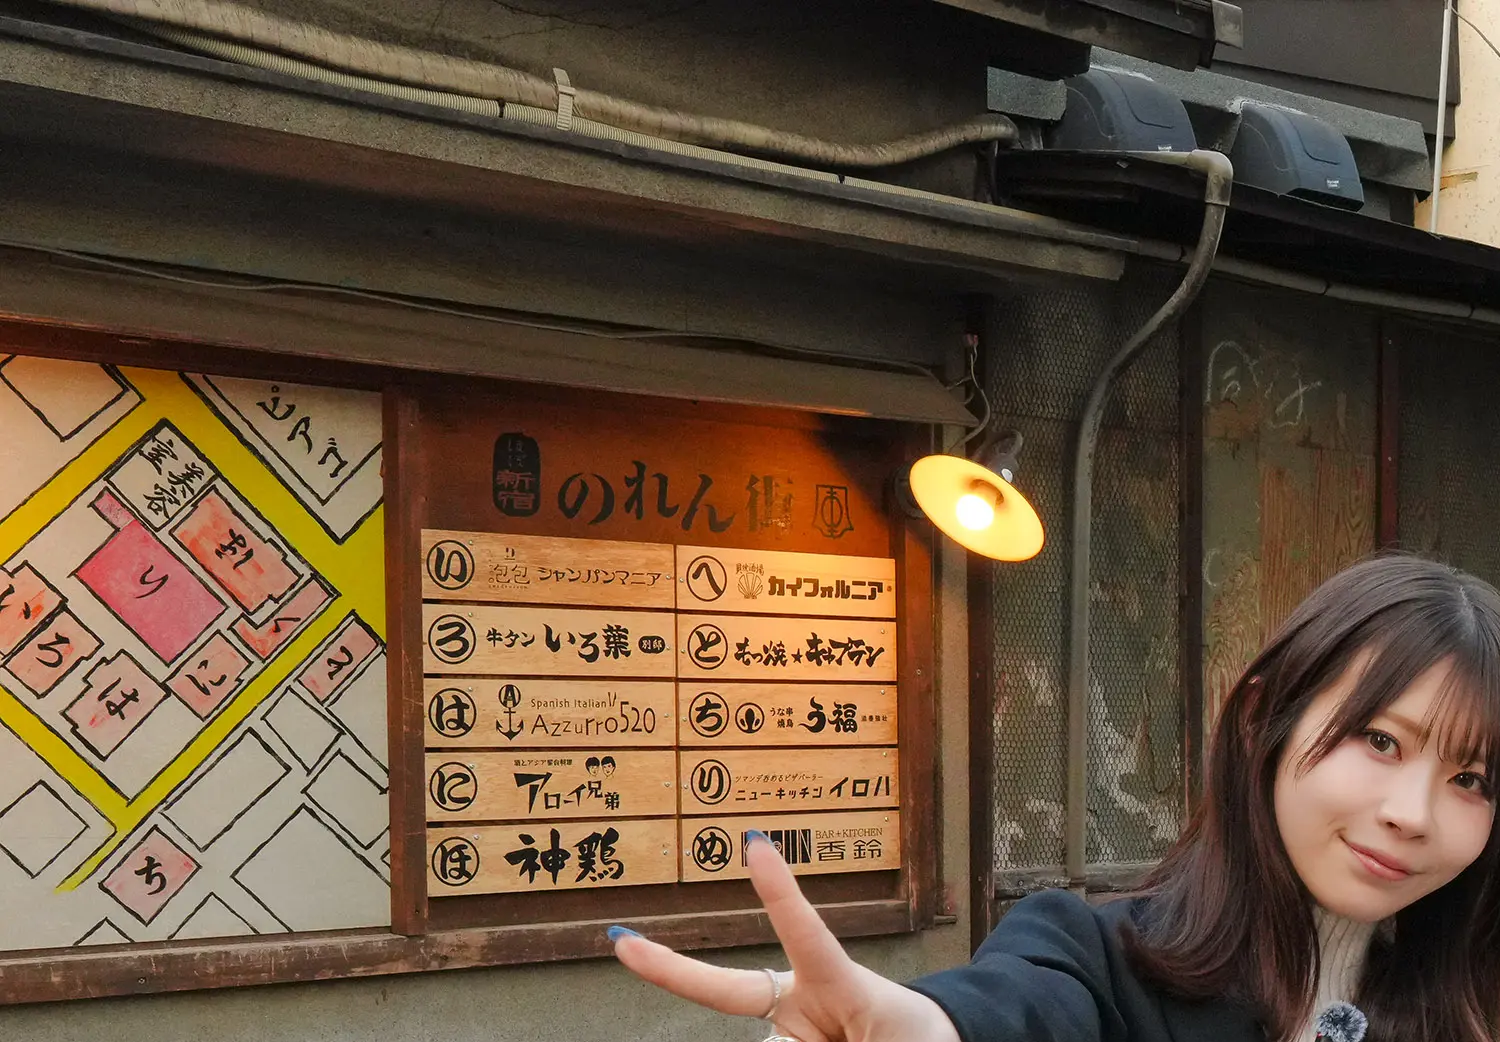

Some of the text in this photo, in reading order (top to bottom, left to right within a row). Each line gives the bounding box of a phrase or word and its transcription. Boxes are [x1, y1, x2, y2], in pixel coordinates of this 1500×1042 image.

[432, 545, 469, 584] い
[537, 567, 662, 587] シャンパンマニア
[690, 560, 725, 597] へ
[768, 575, 883, 600] カイフォルニア
[35, 632, 70, 668] ろ
[433, 620, 471, 660] ろ
[486, 623, 632, 663] 牛タン いろ葉
[640, 638, 664, 652] 別邸
[693, 628, 723, 664] と
[97, 677, 140, 720] は
[433, 692, 473, 734] は
[531, 698, 607, 710] Spanish Italian
[693, 696, 725, 733] ち
[770, 707, 794, 717] うな串
[798, 696, 858, 733] う福
[530, 700, 656, 738] Azzurro520
[435, 767, 473, 806] に
[513, 772, 620, 815] アローイ兄弟
[697, 763, 726, 801] り
[735, 776, 890, 801] ニューキッチン イロハ
[695, 829, 730, 867] ぬ
[815, 827, 883, 840] BAR+KITCHEN
[816, 839, 882, 862] 香鈴
[134, 855, 169, 895] ち
[442, 840, 475, 883] ほ
[502, 828, 625, 885] 神鶏
